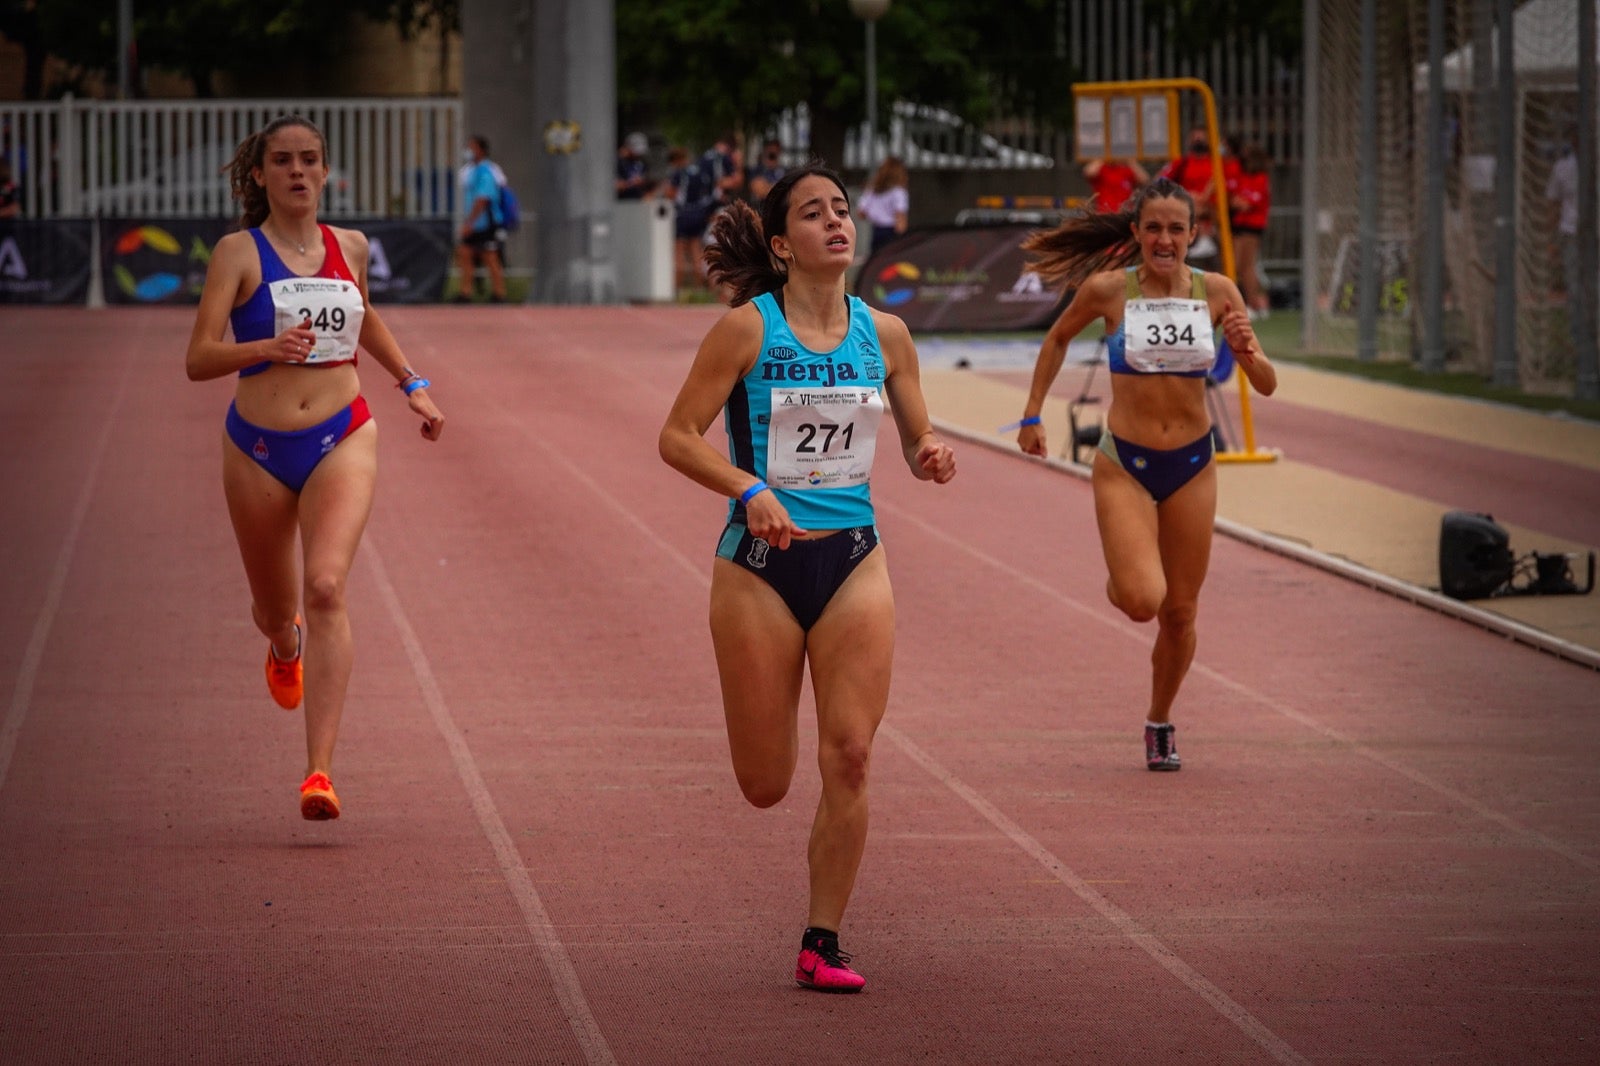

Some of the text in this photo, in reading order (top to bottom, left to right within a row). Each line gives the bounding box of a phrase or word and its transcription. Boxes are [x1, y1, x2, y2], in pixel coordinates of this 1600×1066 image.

[298, 307, 346, 332] 349
[1146, 324, 1195, 345] 334
[770, 348, 796, 359] TROPS
[762, 357, 858, 387] nerja
[800, 393, 810, 406] VI
[795, 422, 854, 453] 271
